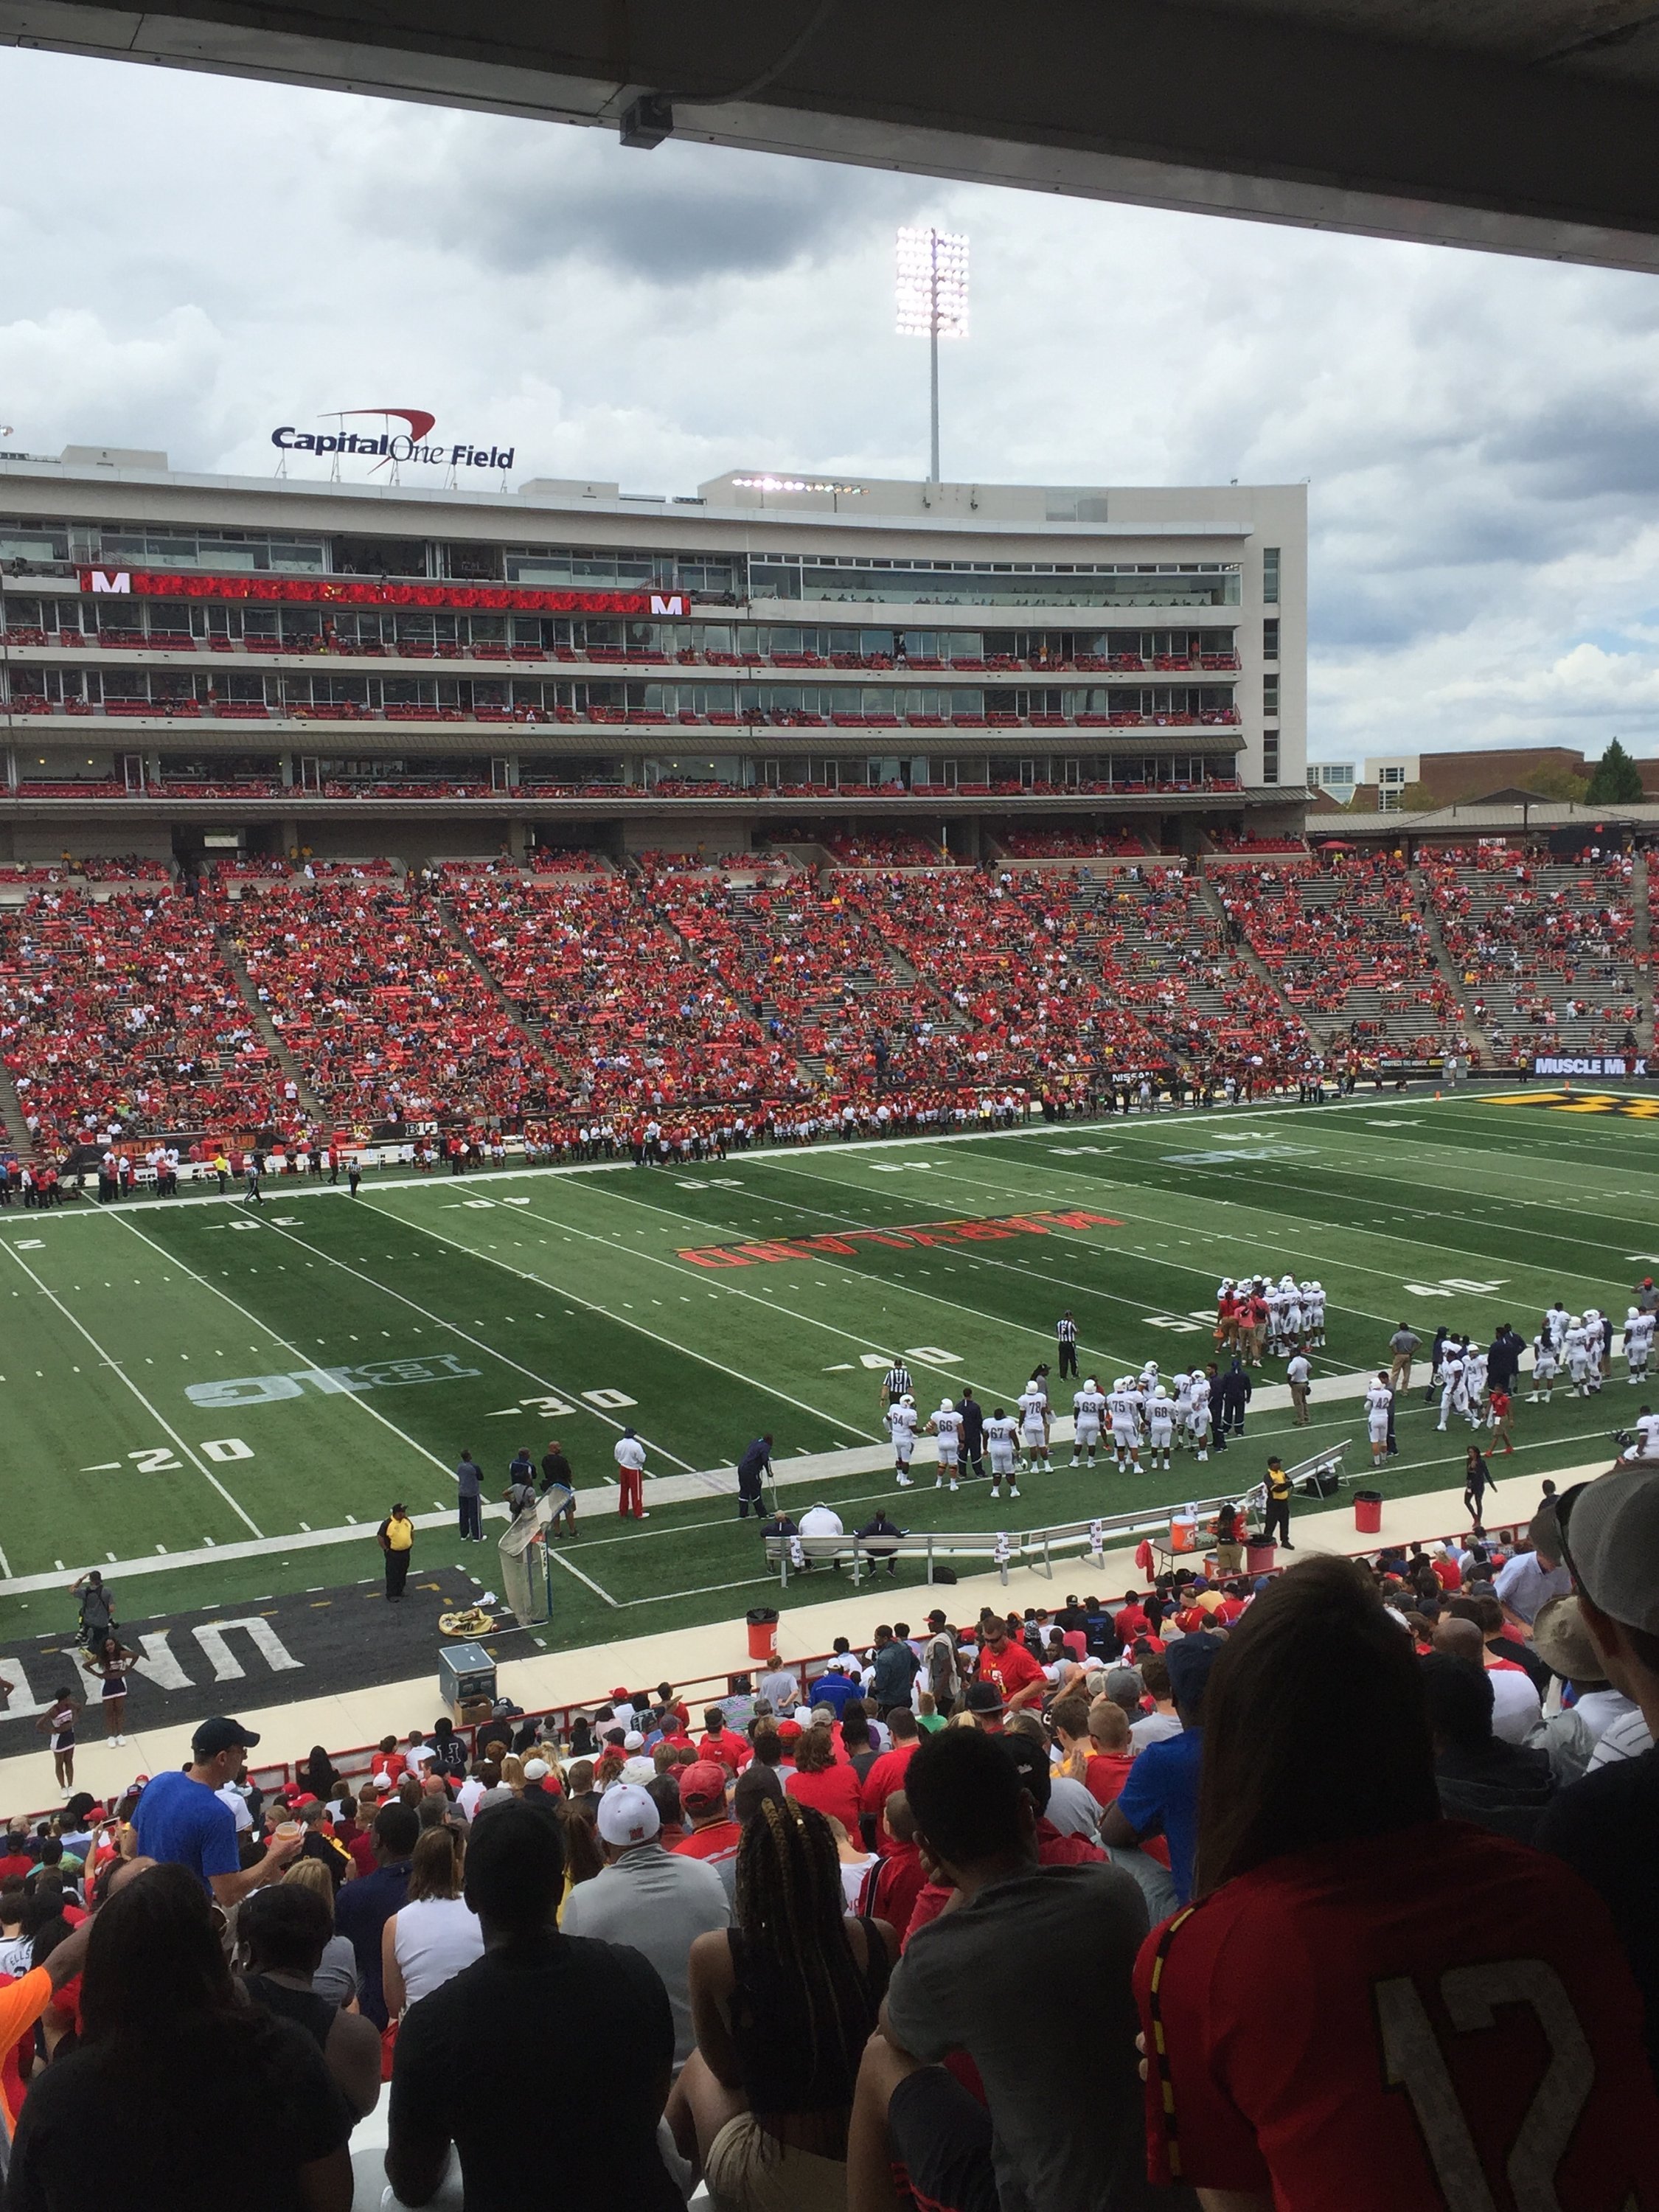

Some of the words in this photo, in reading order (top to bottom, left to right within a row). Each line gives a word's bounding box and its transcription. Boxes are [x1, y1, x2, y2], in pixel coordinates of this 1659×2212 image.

[451, 445, 515, 469] Field
[91, 571, 130, 593] M
[650, 595, 682, 615] M
[1536, 1058, 1601, 1074] MUSCLE
[1604, 1059, 1646, 1074] MIK
[1112, 1071, 1153, 1082] NISSAN
[677, 1210, 1127, 1268] MARYLAND
[1402, 1279, 1500, 1297] 40
[859, 1347, 964, 1369] 40
[895, 1372, 902, 1383] U
[519, 1388, 639, 1418] 30
[1029, 1402, 1041, 1413] 78
[1082, 1401, 1096, 1413] 63
[1112, 1401, 1125, 1413] 75
[1376, 1397, 1388, 1409] 42
[939, 1419, 953, 1432] 66
[990, 1427, 1004, 1439] 67
[128, 1439, 255, 1473] 20
